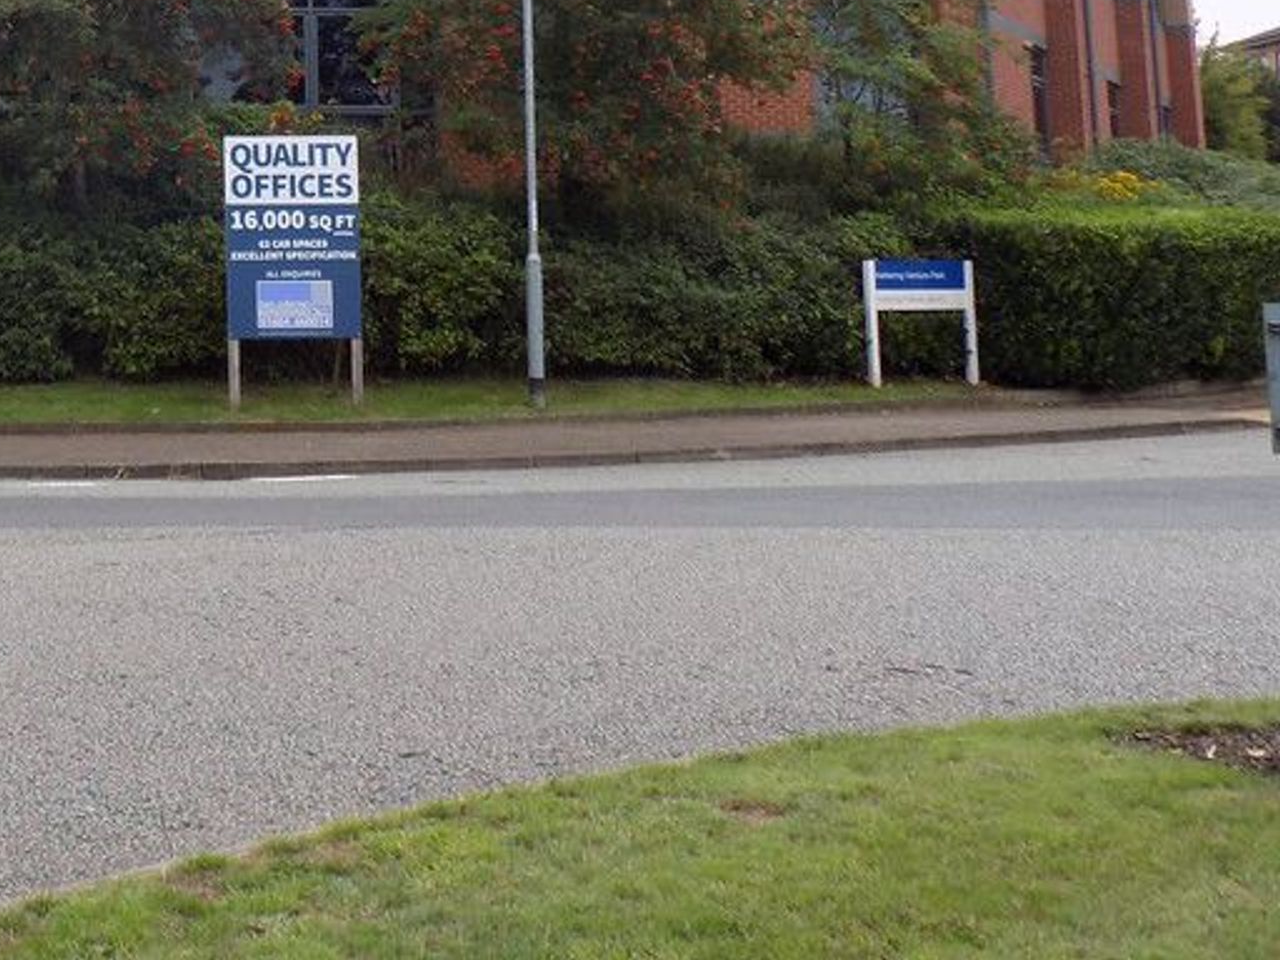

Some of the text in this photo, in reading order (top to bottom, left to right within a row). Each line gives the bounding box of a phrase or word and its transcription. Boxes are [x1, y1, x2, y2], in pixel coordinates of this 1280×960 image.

[230, 143, 353, 173] QUALITY
[231, 174, 353, 198] OFFICES
[230, 210, 357, 231] 16,000 SQ FT
[272, 239, 291, 249] CAR
[293, 239, 328, 249] SPACES
[230, 250, 357, 261] EXCELLENT SPECIFICATION
